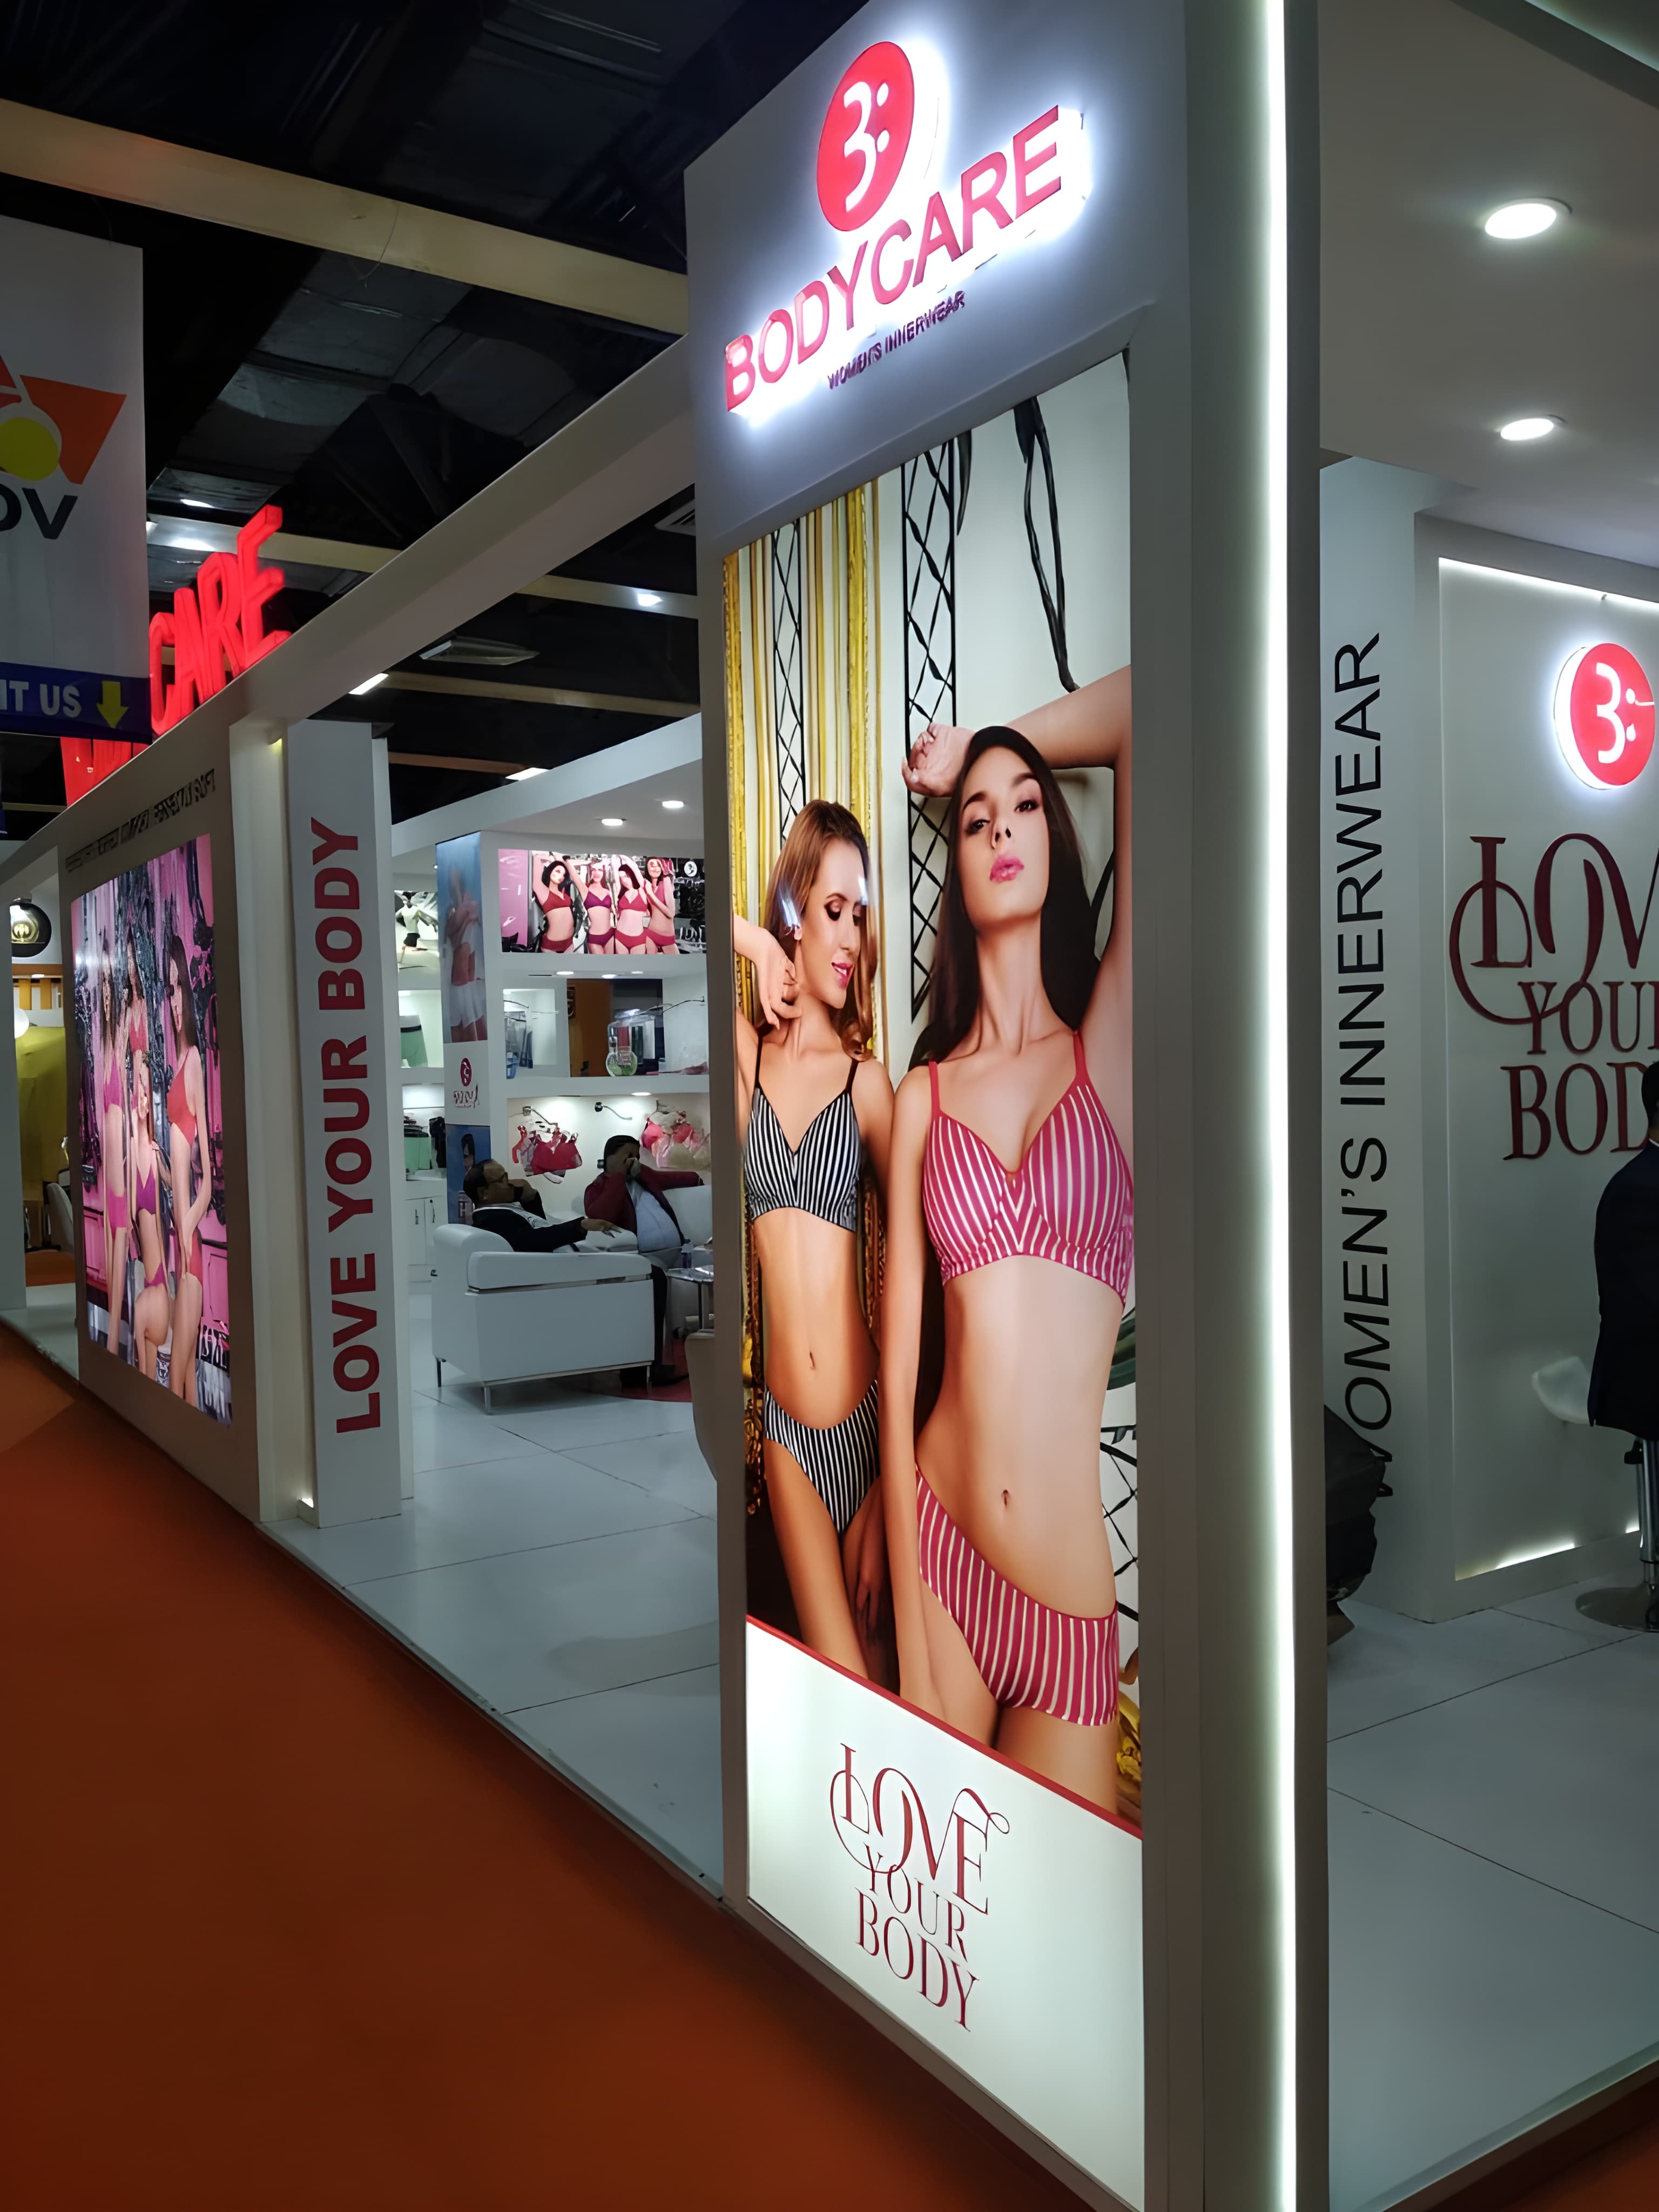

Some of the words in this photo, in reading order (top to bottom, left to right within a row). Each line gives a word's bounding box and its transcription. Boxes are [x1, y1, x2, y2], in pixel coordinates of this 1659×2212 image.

[725, 104, 1062, 412] BODYCARE
[39, 683, 82, 718] US
[311, 817, 366, 1010] BODY
[1334, 631, 1386, 1106] INNERWEAR
[1517, 981, 1659, 1055] YOU
[321, 1035, 374, 1233] YOUR
[330, 1253, 381, 1433] LOVE
[1340, 1137, 1393, 1498] OMEN'S
[830, 1743, 1010, 1916] LOVE
[862, 1842, 968, 1963] YOUR
[854, 1887, 980, 2032] BODY
